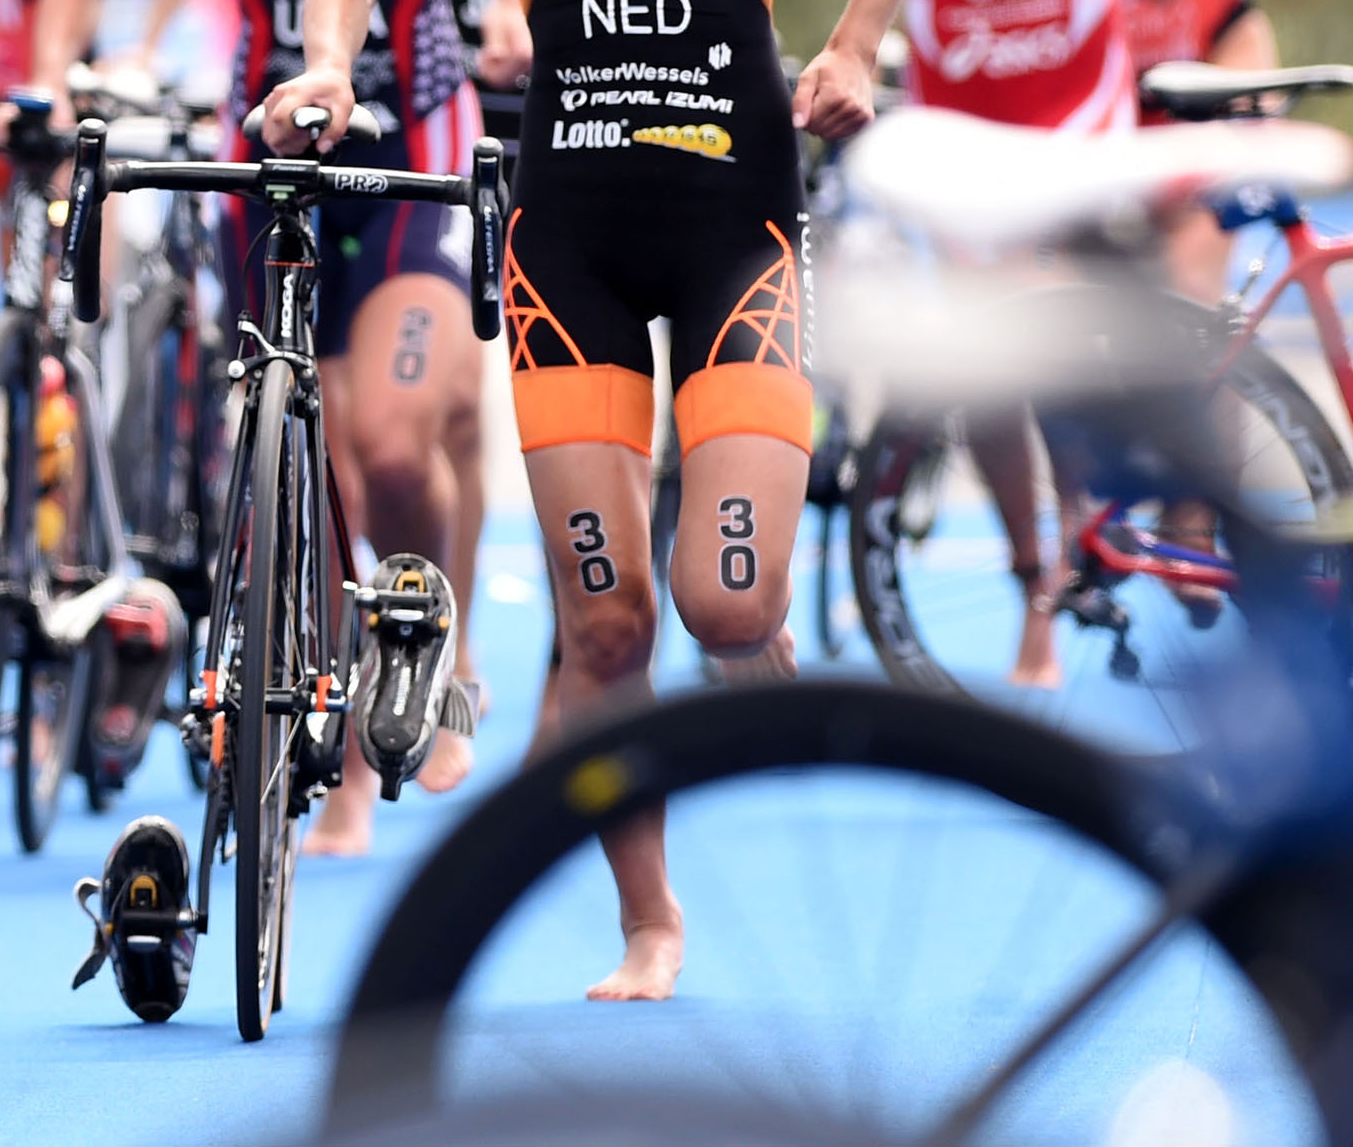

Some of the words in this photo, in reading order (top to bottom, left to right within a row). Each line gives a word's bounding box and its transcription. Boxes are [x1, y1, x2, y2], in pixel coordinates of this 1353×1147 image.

[556, 62, 710, 86] VolkerWessels
[590, 89, 662, 106] PEARL
[664, 91, 734, 114] IZUMI
[280, 273, 294, 338] KOGA
[567, 508, 616, 595] 30
[715, 494, 758, 593] 30
